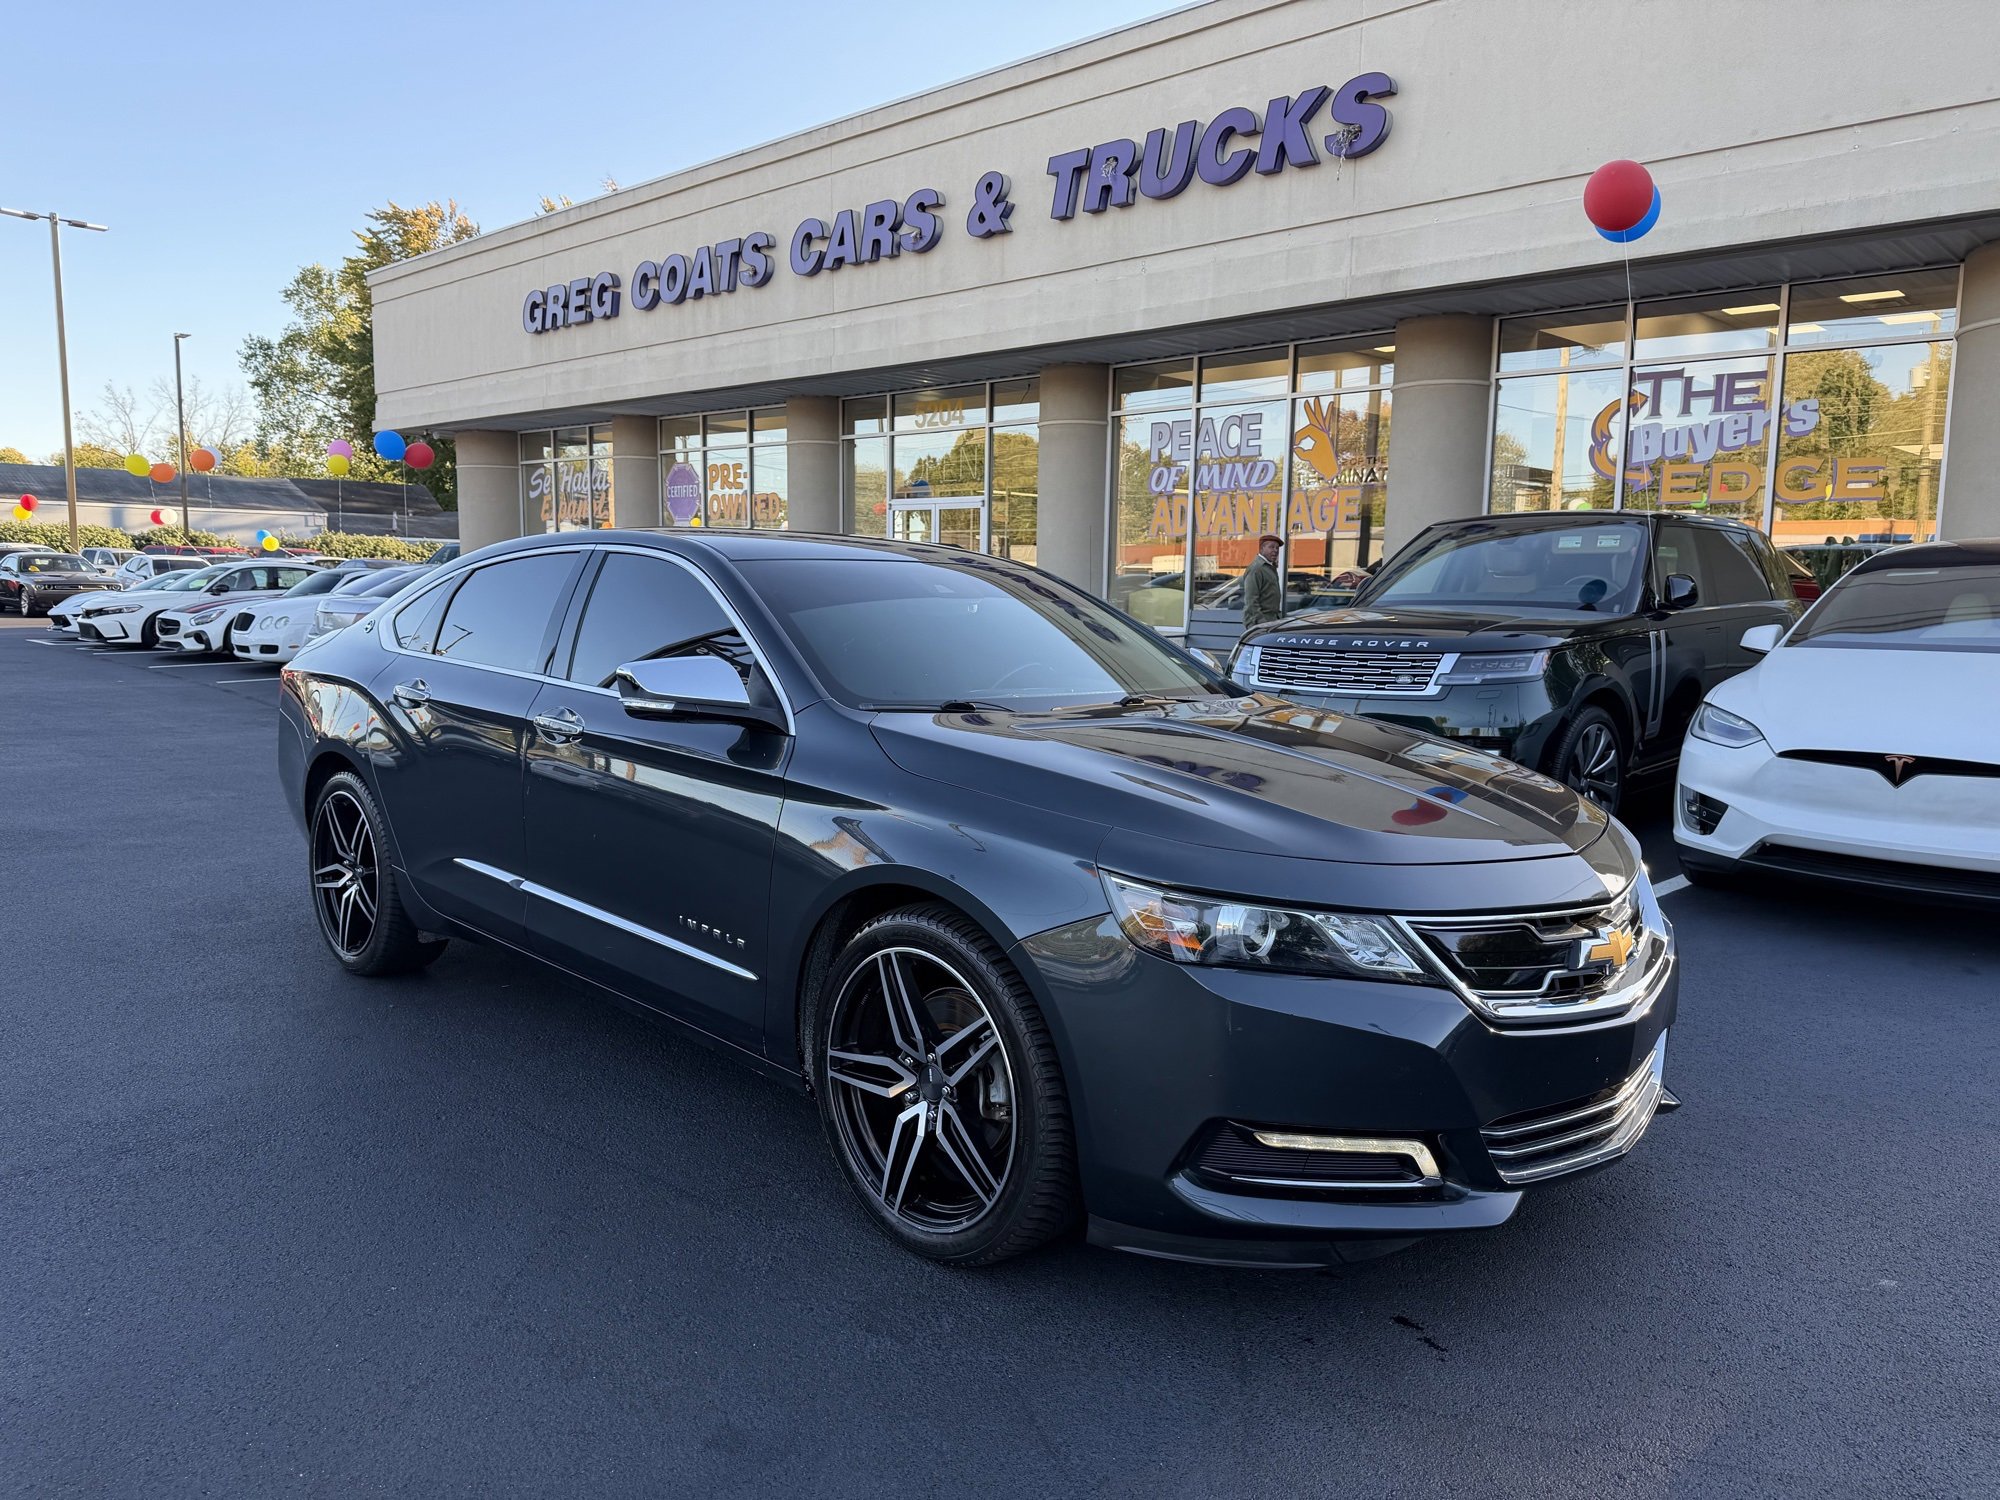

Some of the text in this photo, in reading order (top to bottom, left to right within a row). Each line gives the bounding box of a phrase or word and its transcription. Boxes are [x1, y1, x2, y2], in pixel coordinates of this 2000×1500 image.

[523, 71, 1398, 334] GREG COATS CARS & TRUCKS
[1632, 367, 1768, 419] THE
[914, 400, 965, 428] 5204
[1150, 413, 1262, 463] PEACE
[529, 467, 551, 499] Se
[666, 483, 699, 498] CERTIFIED
[708, 463, 748, 491] PRE-
[1150, 465, 1186, 493] OF
[1195, 460, 1277, 492] MIND
[1656, 455, 1888, 505] EDGE
[1150, 486, 1362, 538] ADVANTAGE
[1276, 636, 1430, 648] RANGE ROVER
